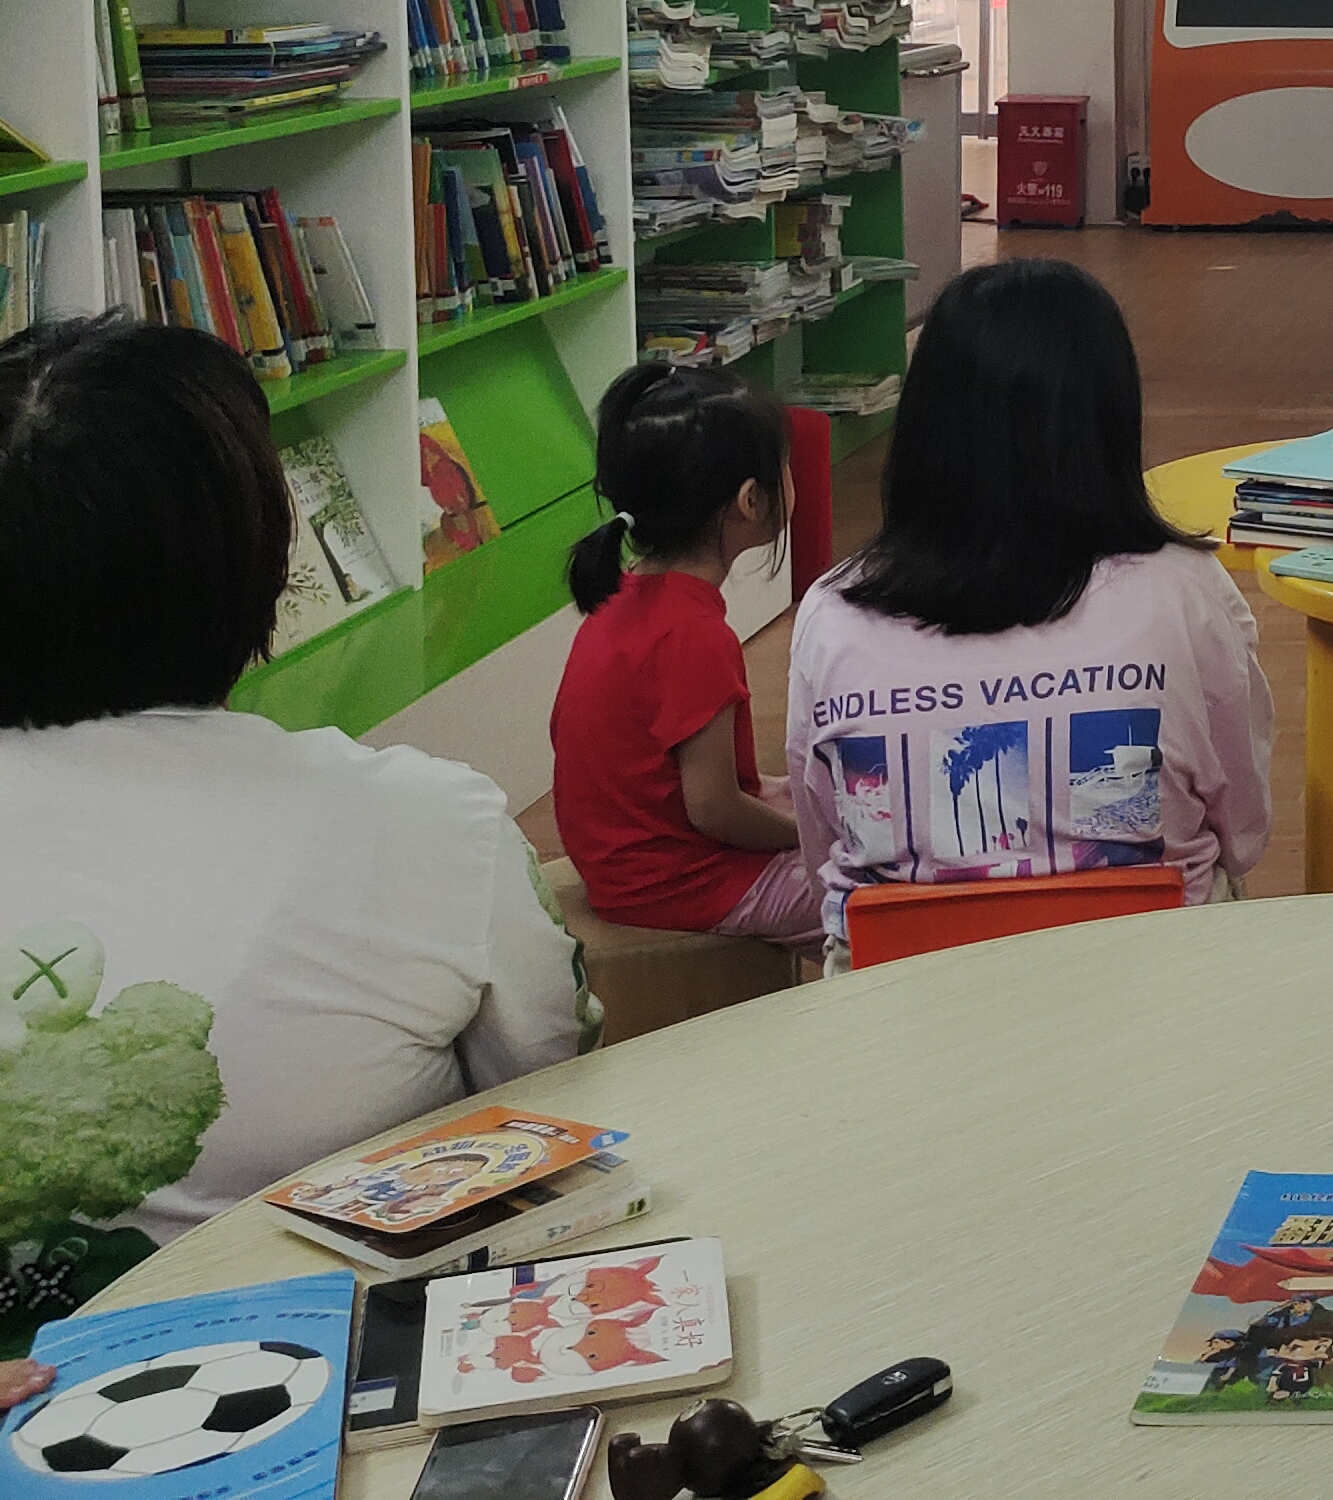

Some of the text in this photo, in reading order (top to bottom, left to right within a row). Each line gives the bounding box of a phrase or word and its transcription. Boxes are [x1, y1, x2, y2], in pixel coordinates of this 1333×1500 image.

[1045, 183, 1064, 199] 119
[812, 662, 1168, 728] ENDLESS VACATION
